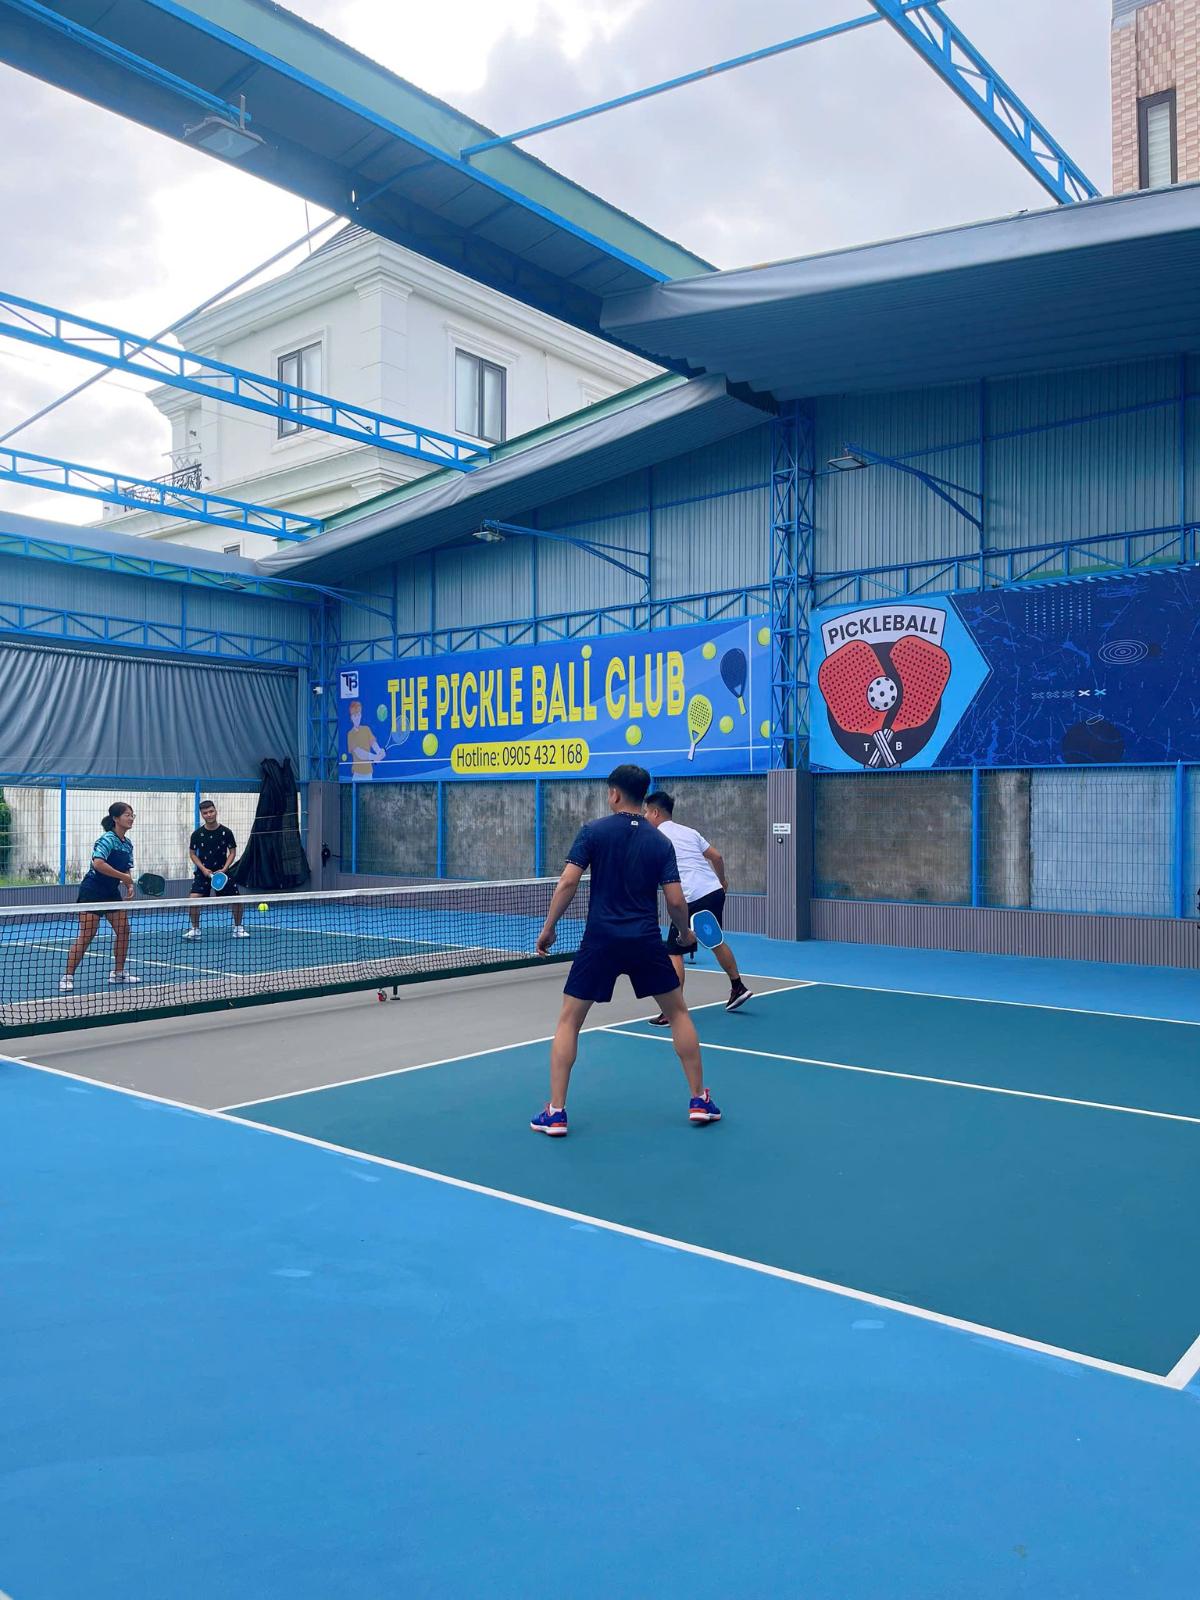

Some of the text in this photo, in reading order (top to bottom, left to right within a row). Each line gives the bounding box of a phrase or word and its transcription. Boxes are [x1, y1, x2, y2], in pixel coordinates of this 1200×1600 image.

[828, 614, 938, 645] PICKLEBALL
[387, 650, 686, 733] THE PICKLE BALL CLUB
[456, 743, 583, 767] Hotline: 0905 432 168
[863, 741, 903, 752] T B
